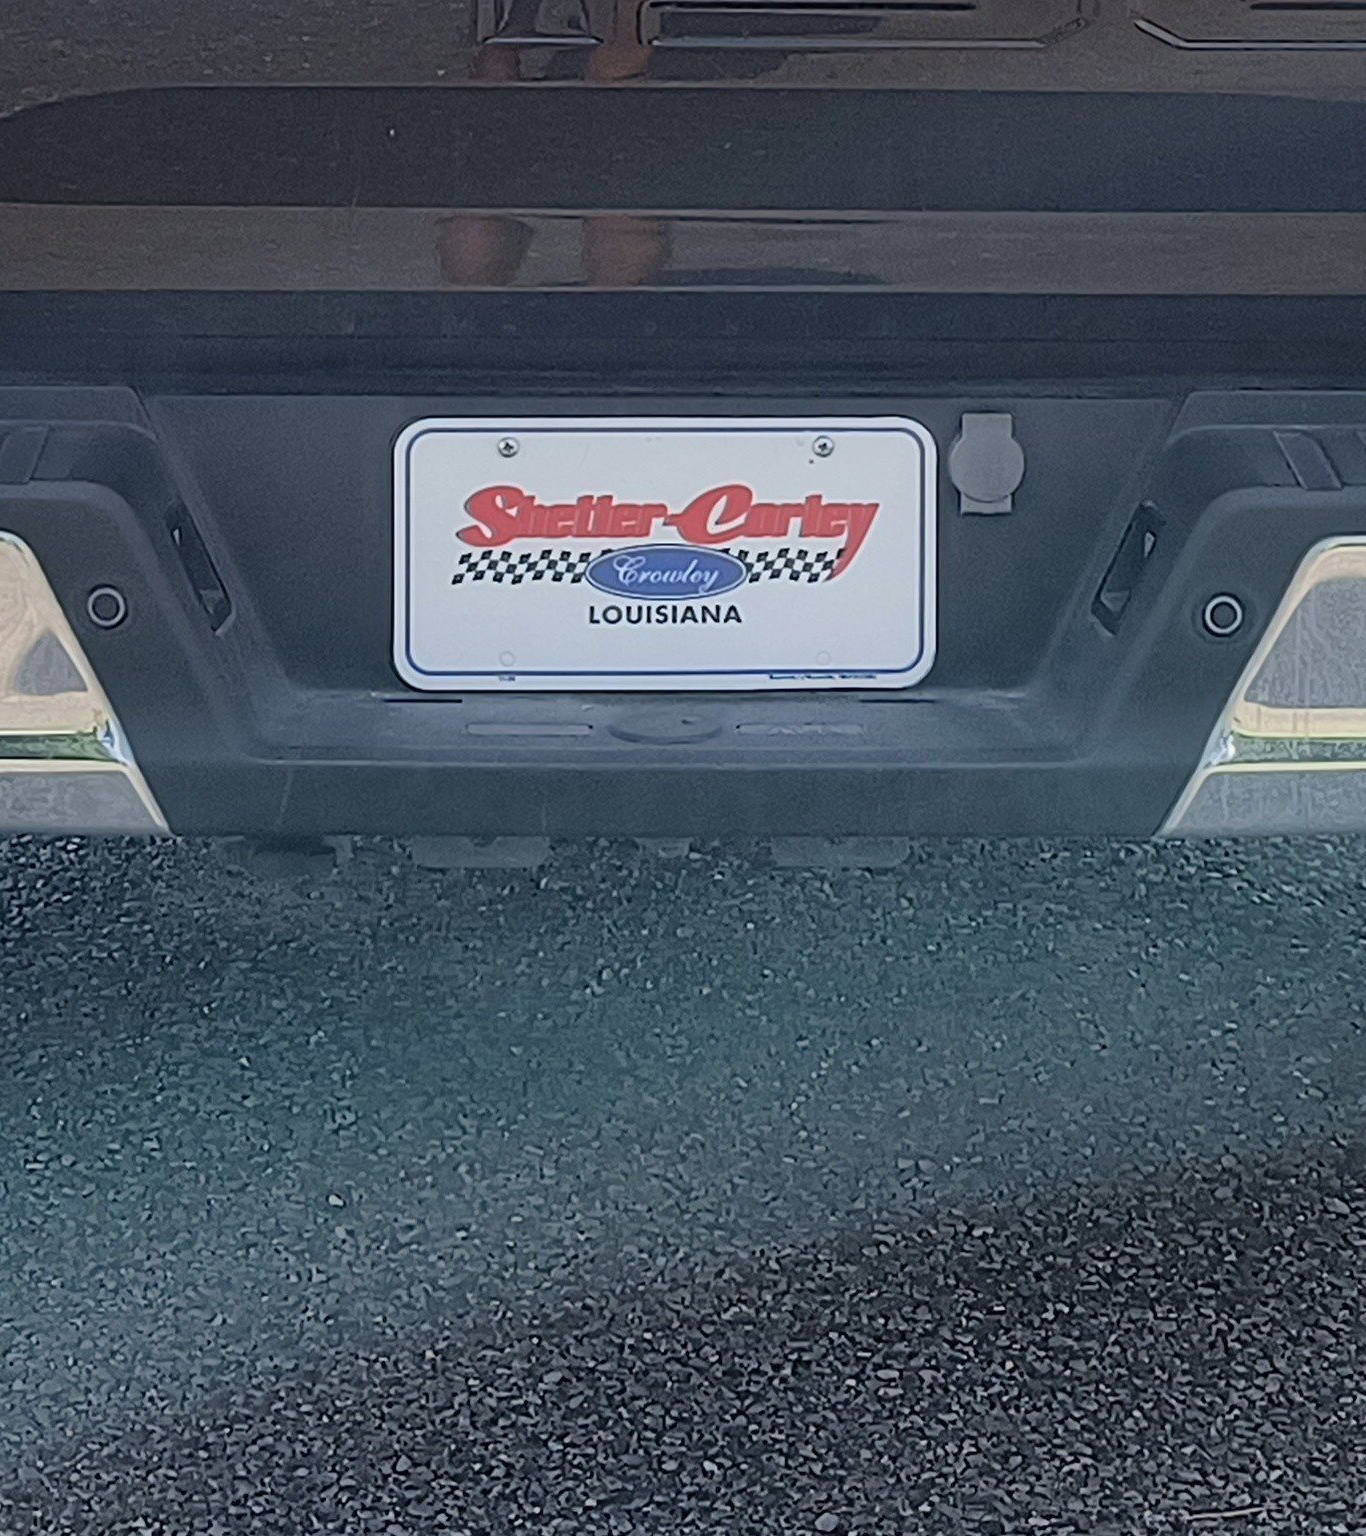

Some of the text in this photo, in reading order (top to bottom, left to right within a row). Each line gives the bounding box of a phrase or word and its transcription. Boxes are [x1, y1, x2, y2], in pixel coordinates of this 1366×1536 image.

[456, 484, 880, 582] Shetler-Corley
[613, 555, 720, 594] Crowley
[588, 604, 743, 625] LOUISIANA
